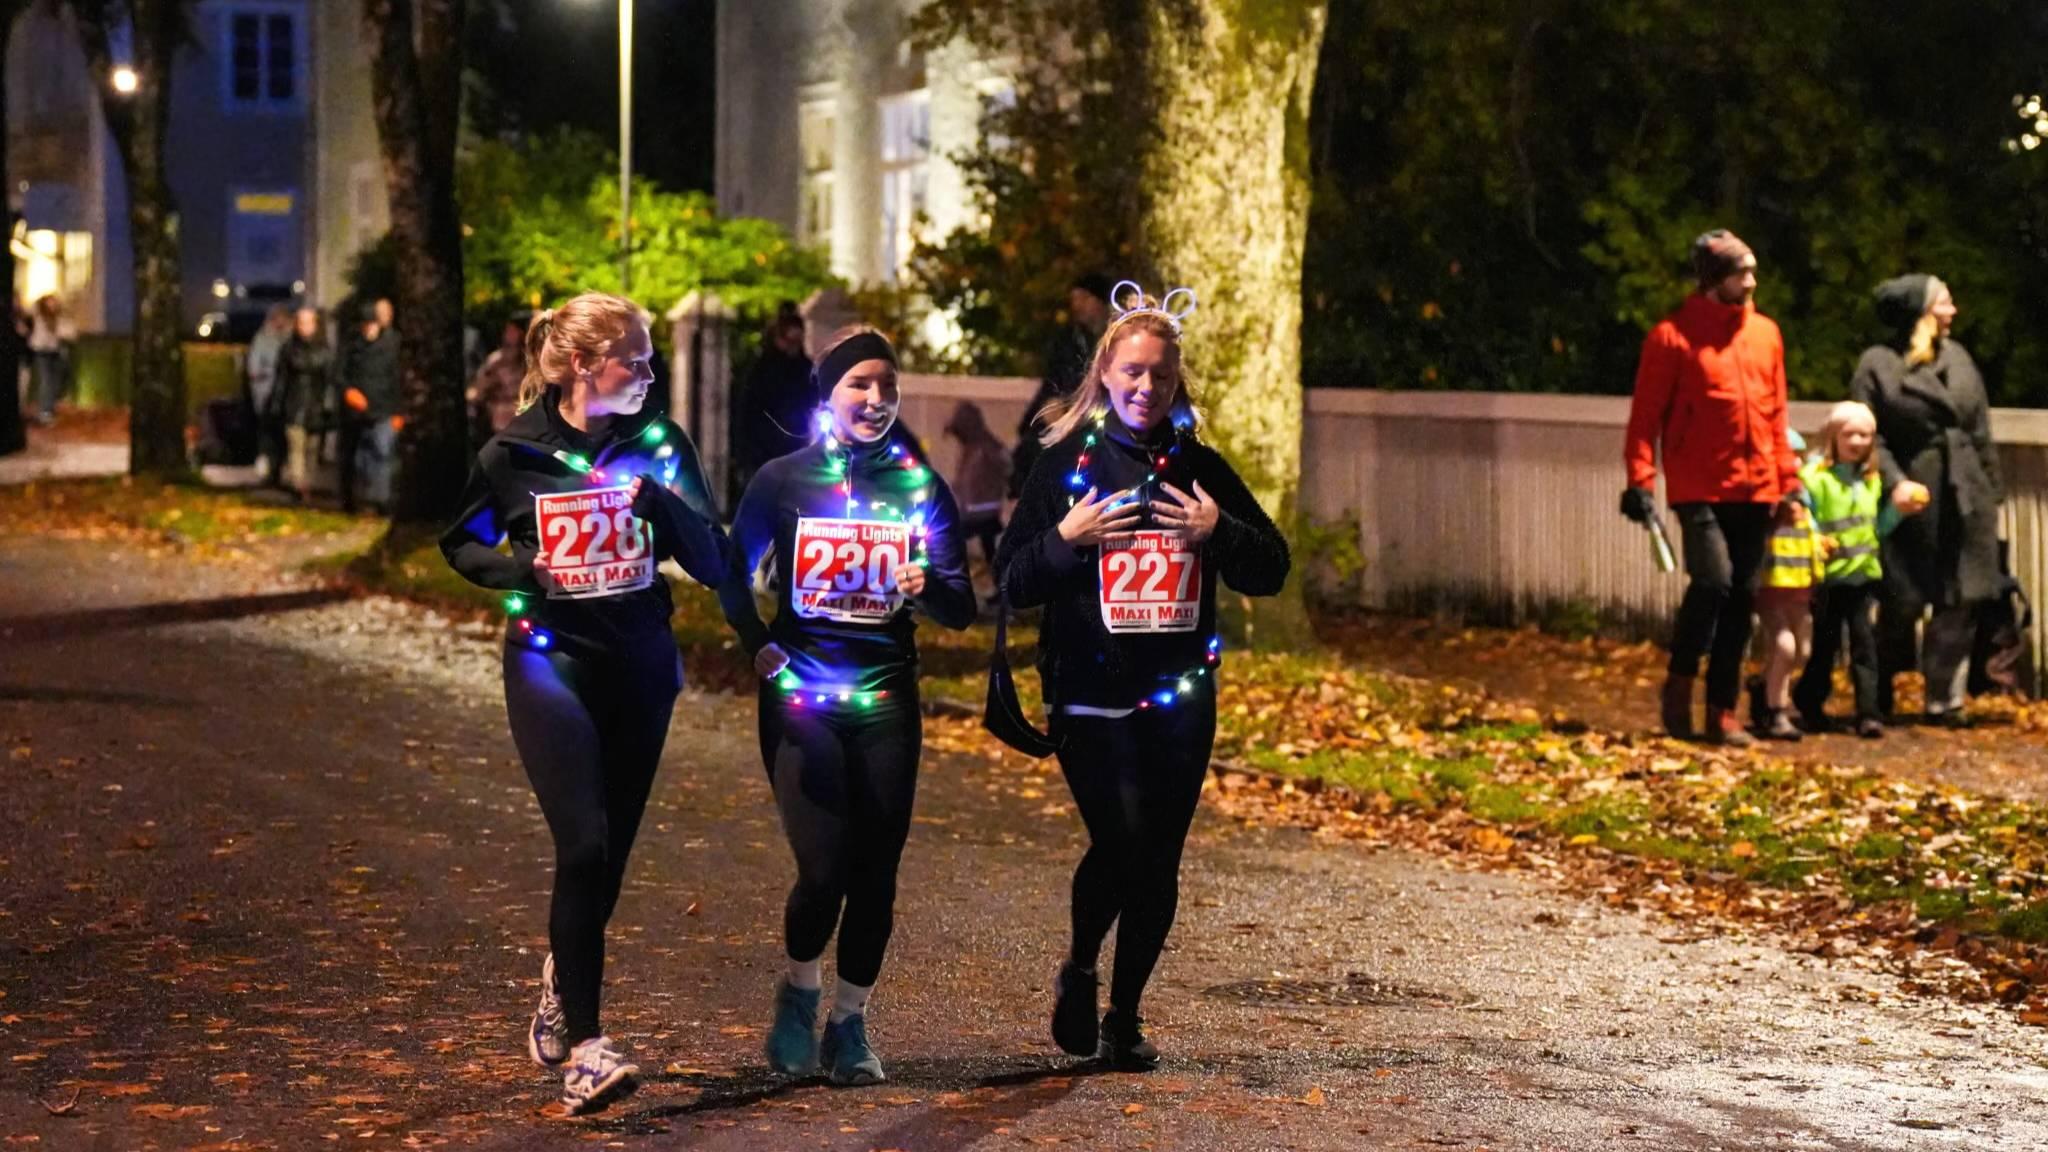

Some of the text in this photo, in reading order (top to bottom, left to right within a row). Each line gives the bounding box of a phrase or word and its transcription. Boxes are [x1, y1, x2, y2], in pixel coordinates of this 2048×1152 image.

[544, 492, 633, 514] Running Ligh
[547, 508, 645, 567] 228
[862, 526, 903, 543] Lights
[802, 539, 899, 594] 230
[1108, 552, 1195, 602] 227
